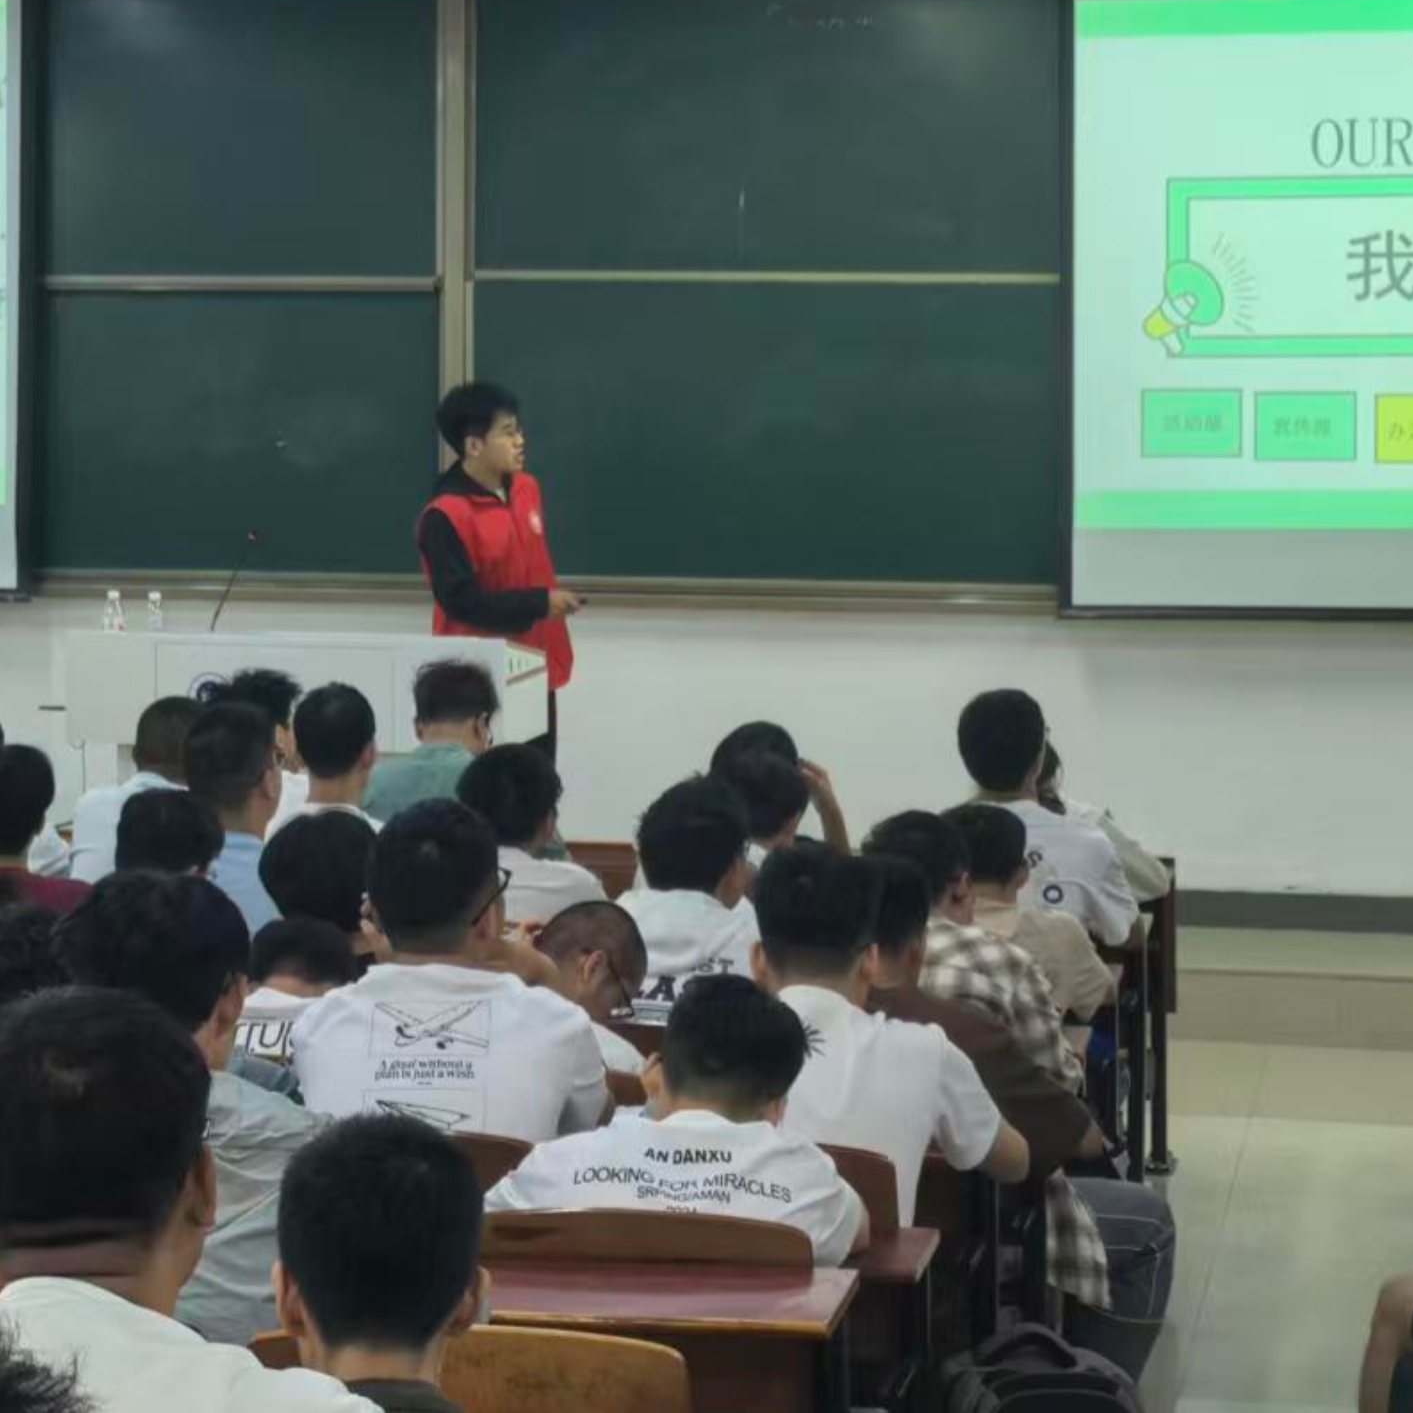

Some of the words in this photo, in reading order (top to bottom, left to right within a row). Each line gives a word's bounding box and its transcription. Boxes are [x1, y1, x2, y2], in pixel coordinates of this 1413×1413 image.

[644, 1148, 669, 1163] AN
[673, 1149, 732, 1165] DANXU
[574, 1167, 655, 1185] LOOKING
[702, 1172, 793, 1203] MIRACLES
